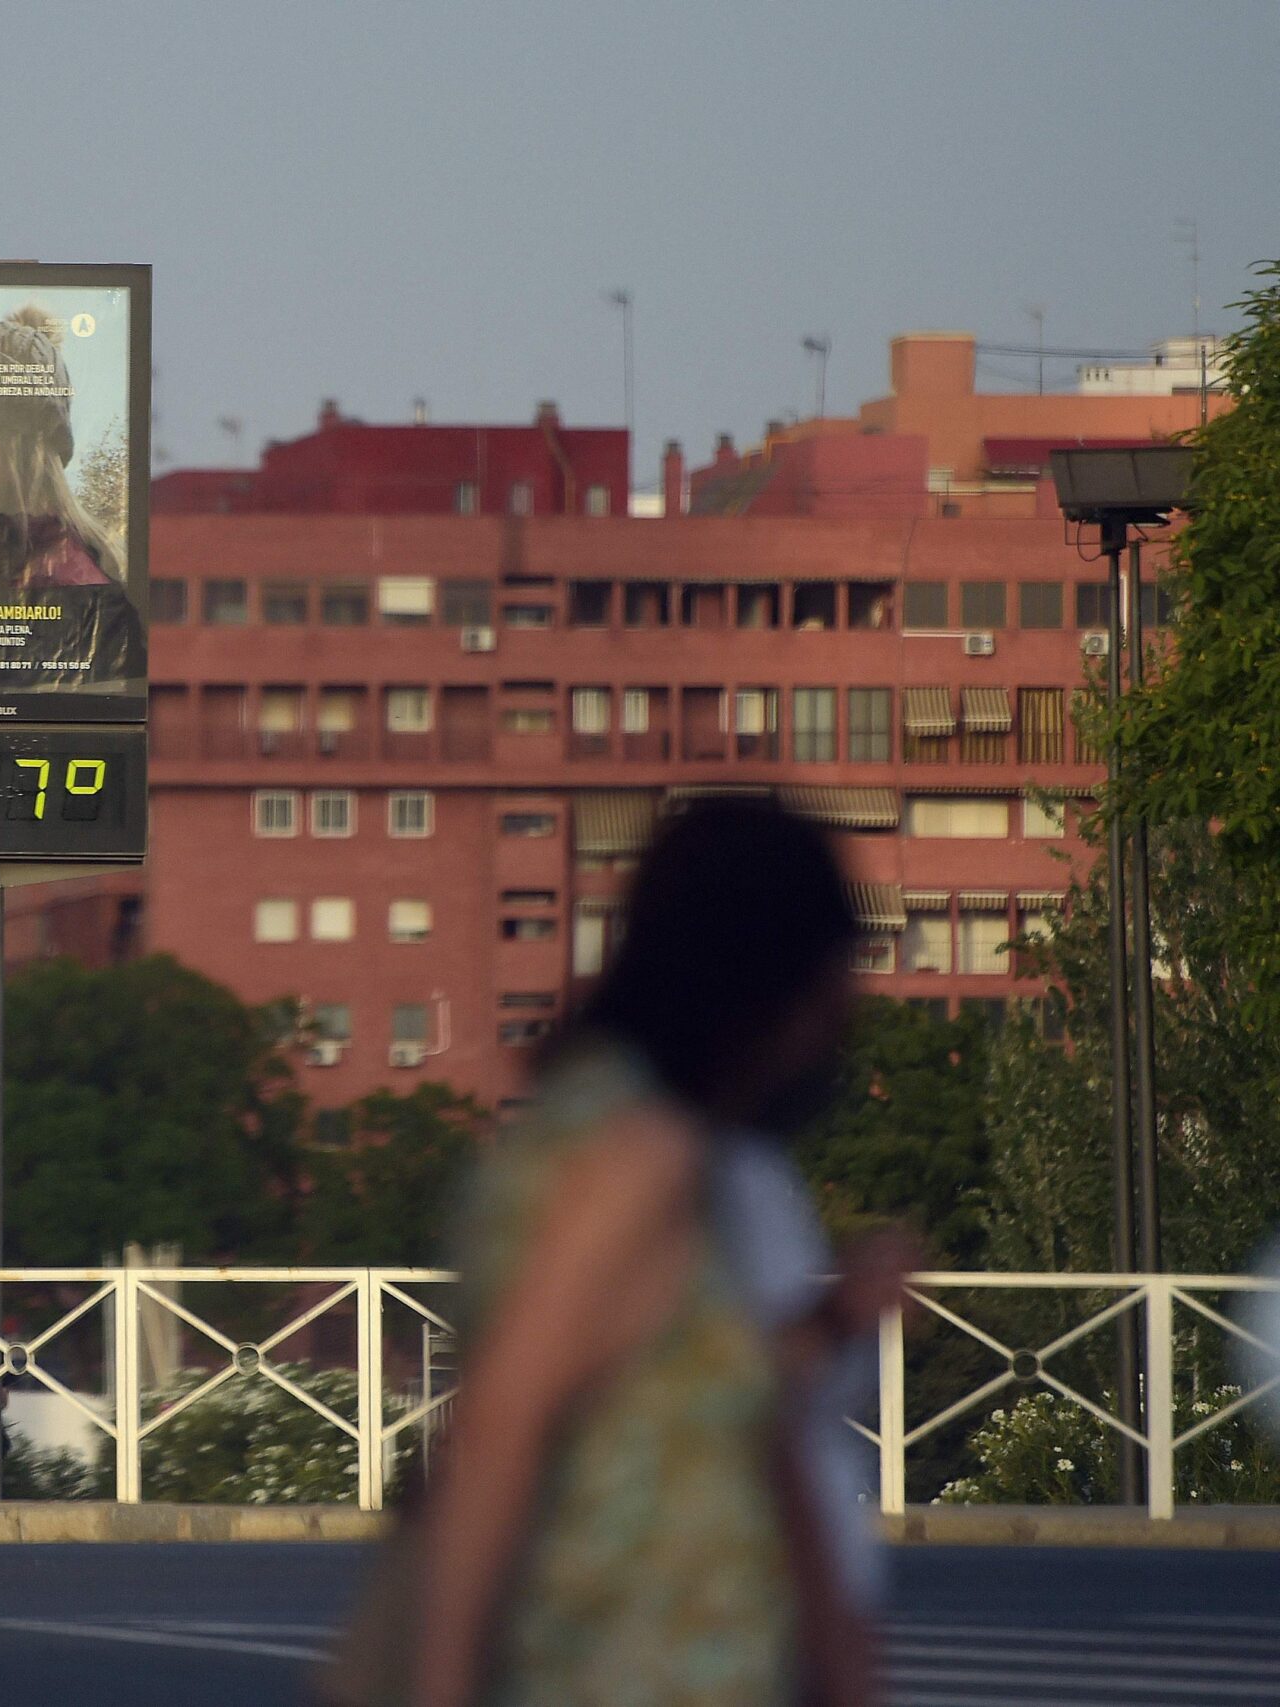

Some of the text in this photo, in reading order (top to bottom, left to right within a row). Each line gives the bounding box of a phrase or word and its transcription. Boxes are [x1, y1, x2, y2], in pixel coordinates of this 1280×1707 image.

[9, 364, 24, 373] POR
[25, 364, 54, 373] DEBAJO
[1, 375, 32, 384] UMBRAL
[45, 375, 54, 384] LA
[23, 386, 33, 396] EN
